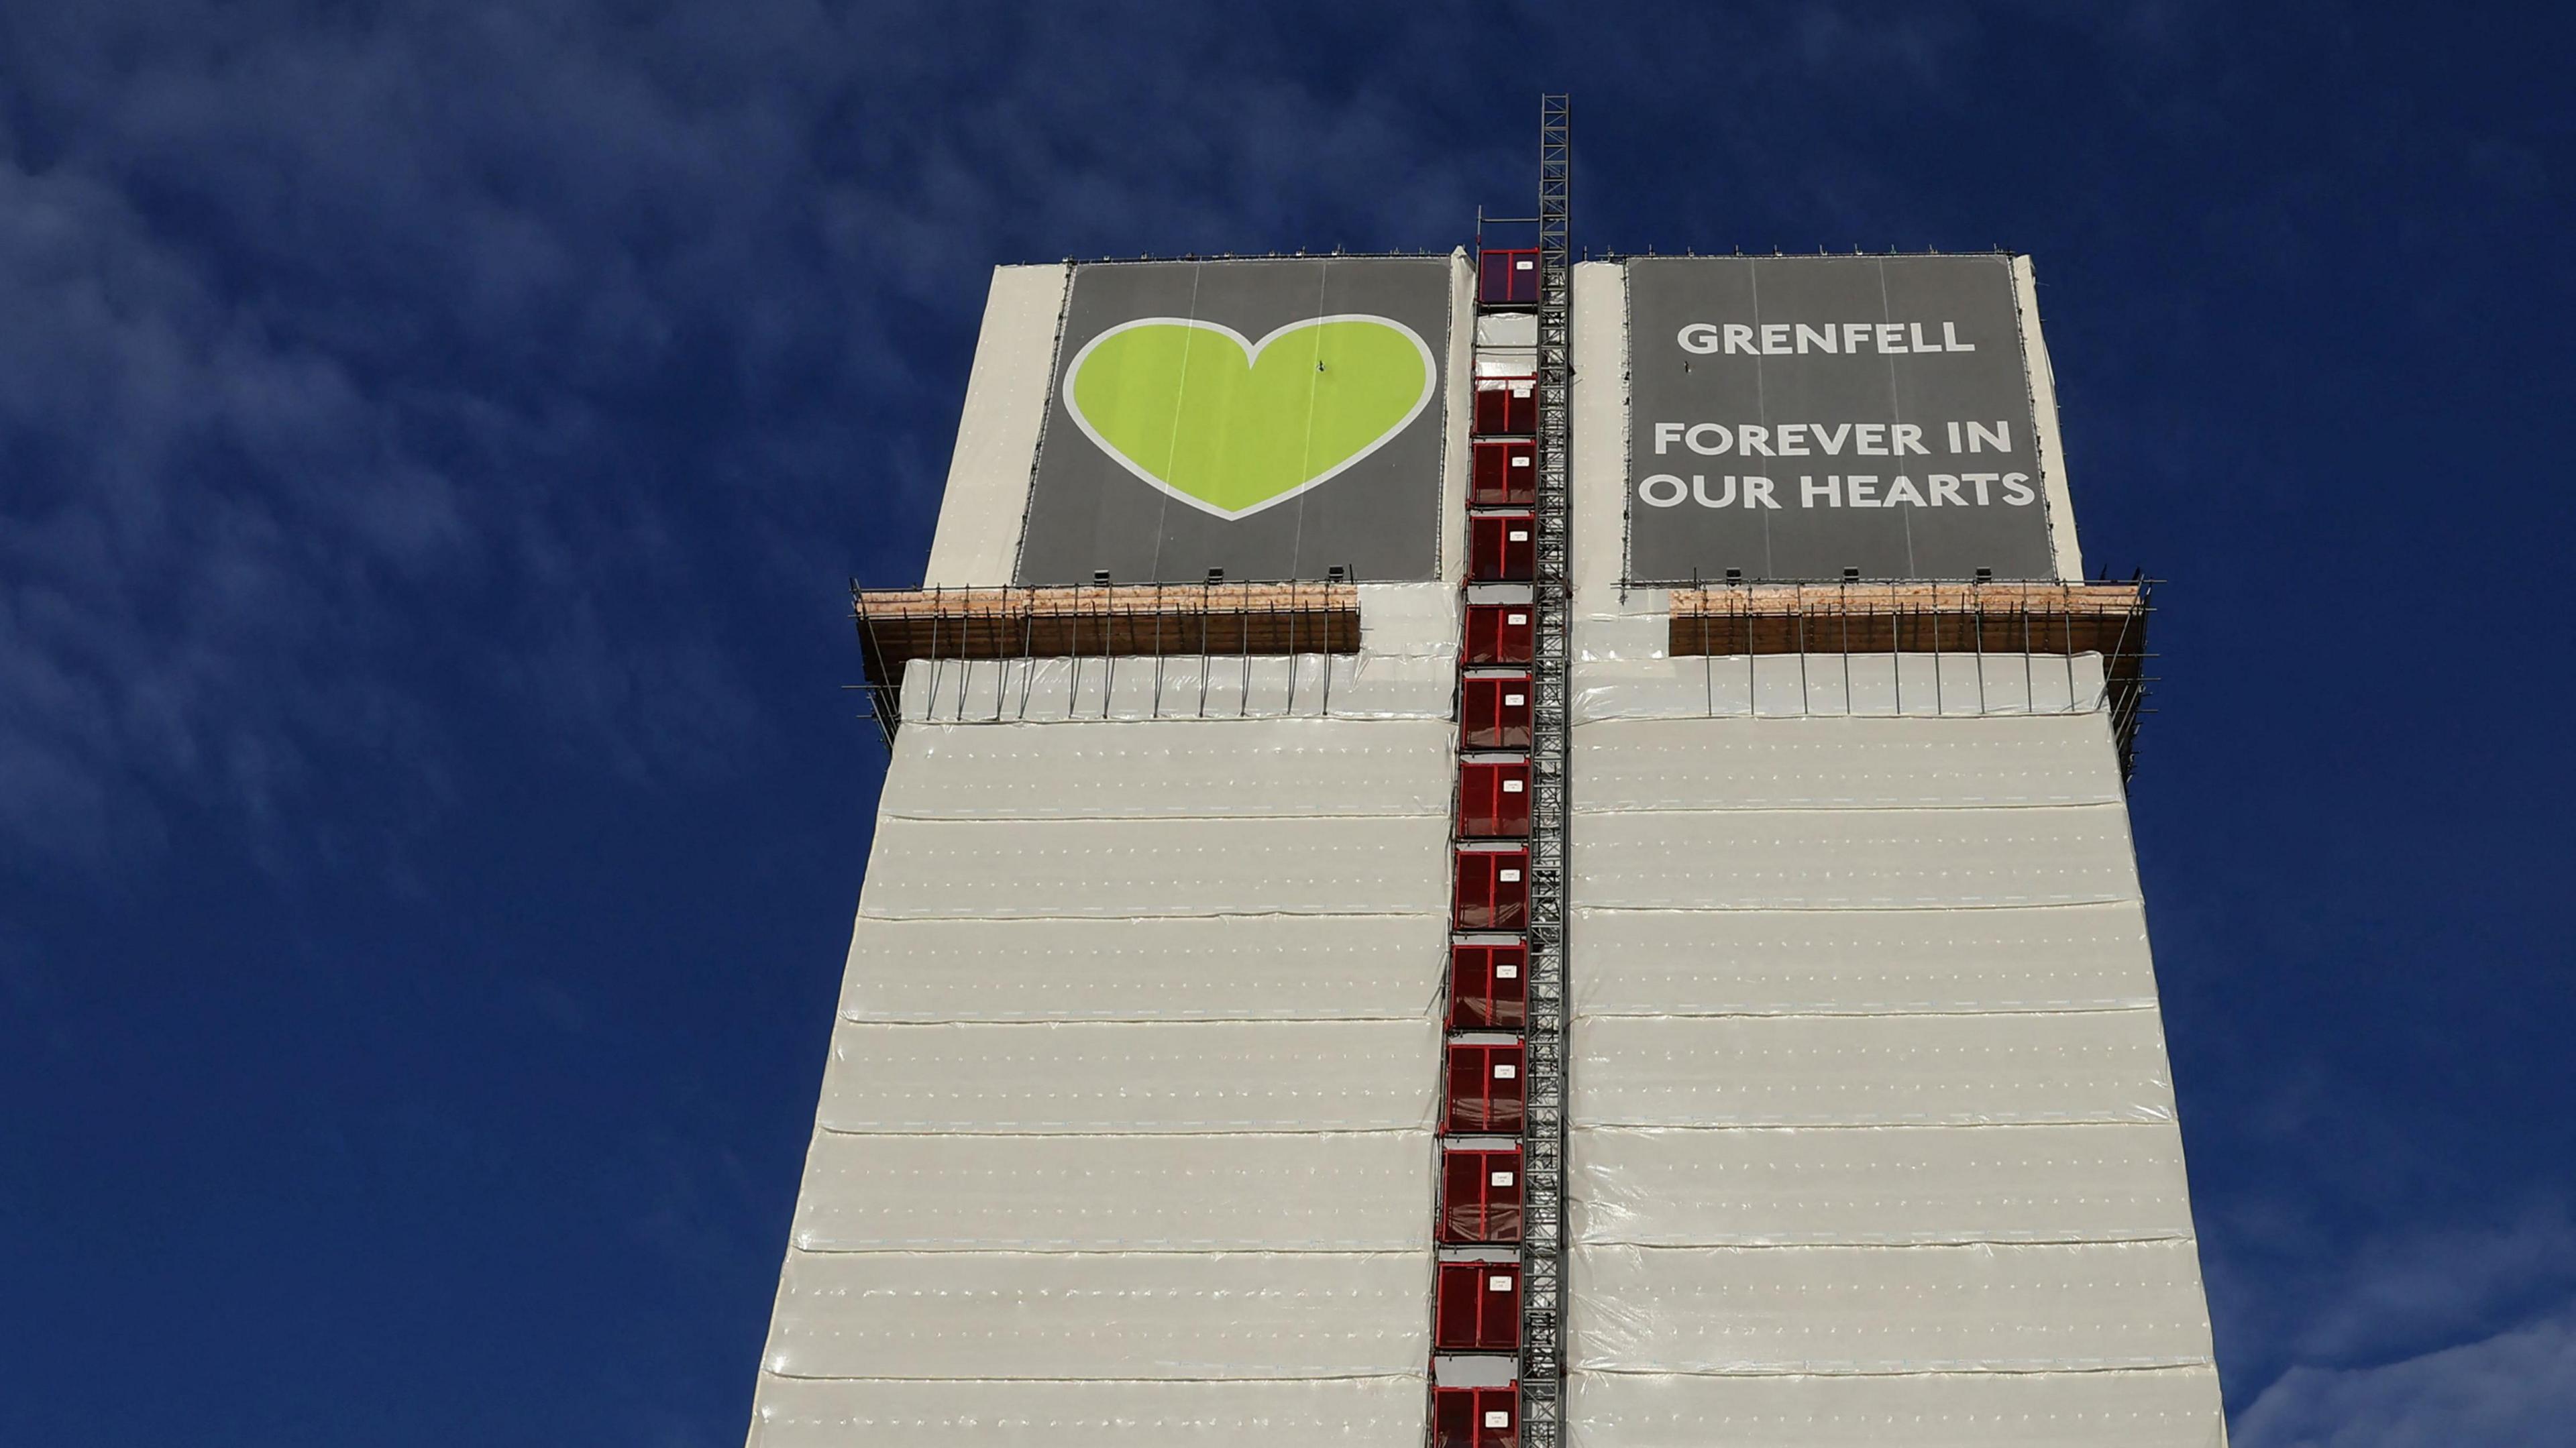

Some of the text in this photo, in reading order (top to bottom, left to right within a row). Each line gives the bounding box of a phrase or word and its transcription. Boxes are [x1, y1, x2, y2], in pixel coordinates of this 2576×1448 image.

[1677, 321, 1976, 355] GRENFELL
[1655, 421, 2012, 457] FOREVER IN
[1638, 471, 2035, 509] OUR HEARTS
